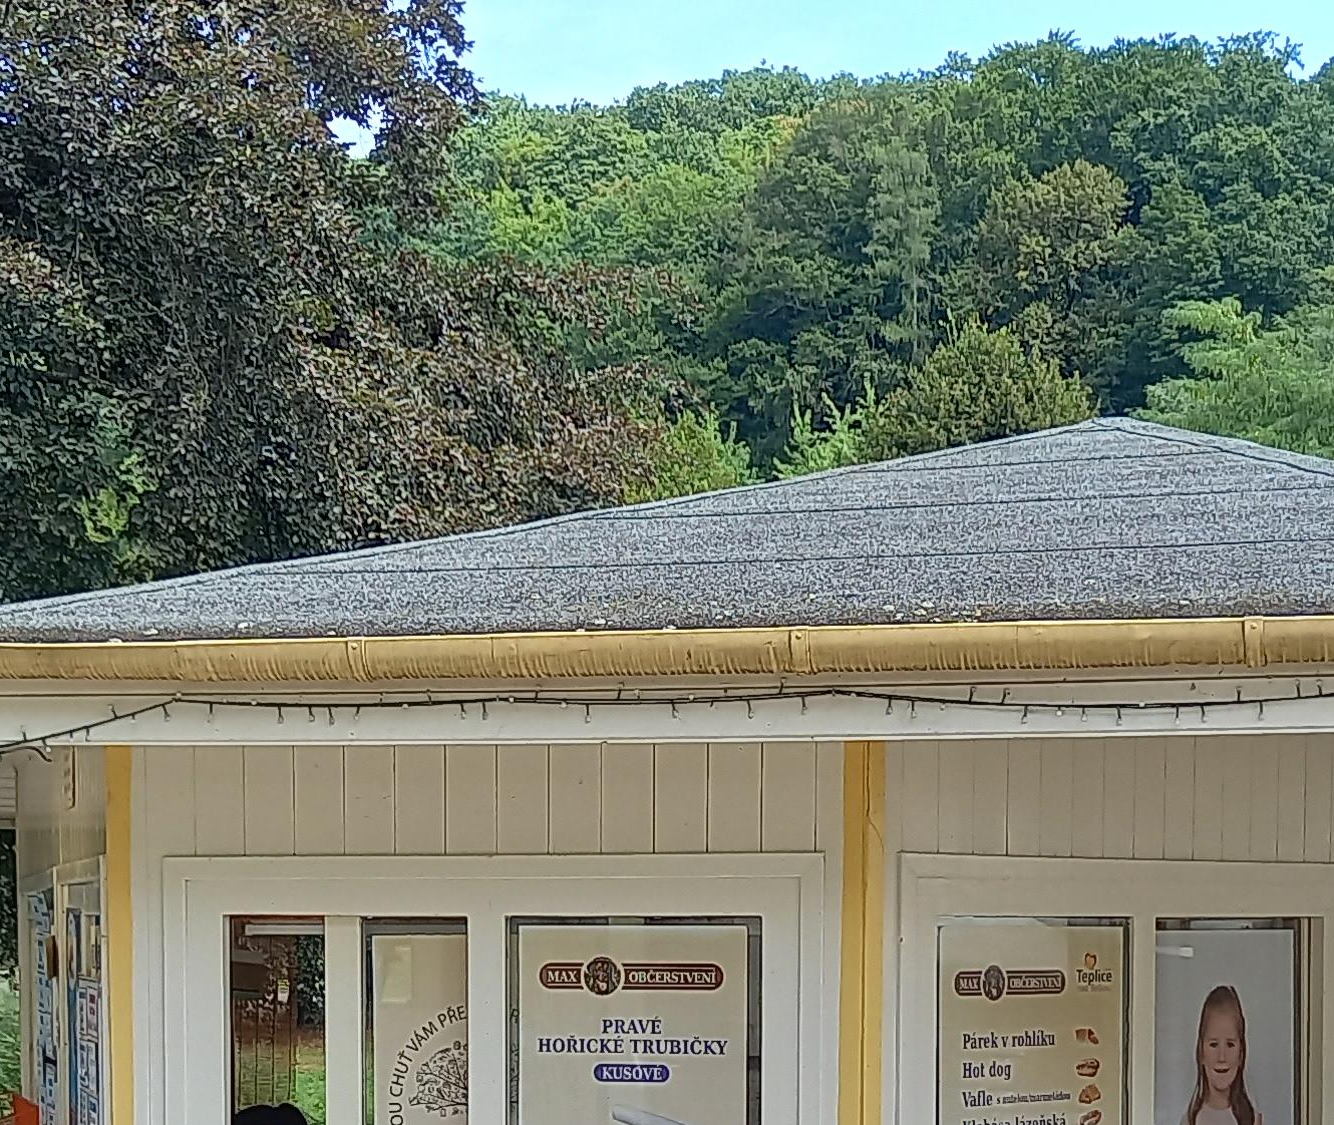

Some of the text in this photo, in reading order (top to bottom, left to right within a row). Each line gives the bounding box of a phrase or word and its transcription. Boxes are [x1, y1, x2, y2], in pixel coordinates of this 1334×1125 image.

[546, 968, 716, 984] MAX OBČERSTVENÍ
[958, 977, 979, 990] MAX
[1076, 969, 1112, 986] Teplice
[601, 1016, 662, 1035] PRAVÉ
[538, 1035, 728, 1056] HOŘICKÉ TRUBIČKY
[962, 1030, 1055, 1049] Párek v rohlíku
[389, 1050, 414, 1098] CHUŤ
[405, 1020, 439, 1052] VÁM
[601, 1063, 663, 1081] KUSOVÉ
[962, 1060, 1011, 1080] Hot dog
[962, 1090, 993, 1107] Vafle
